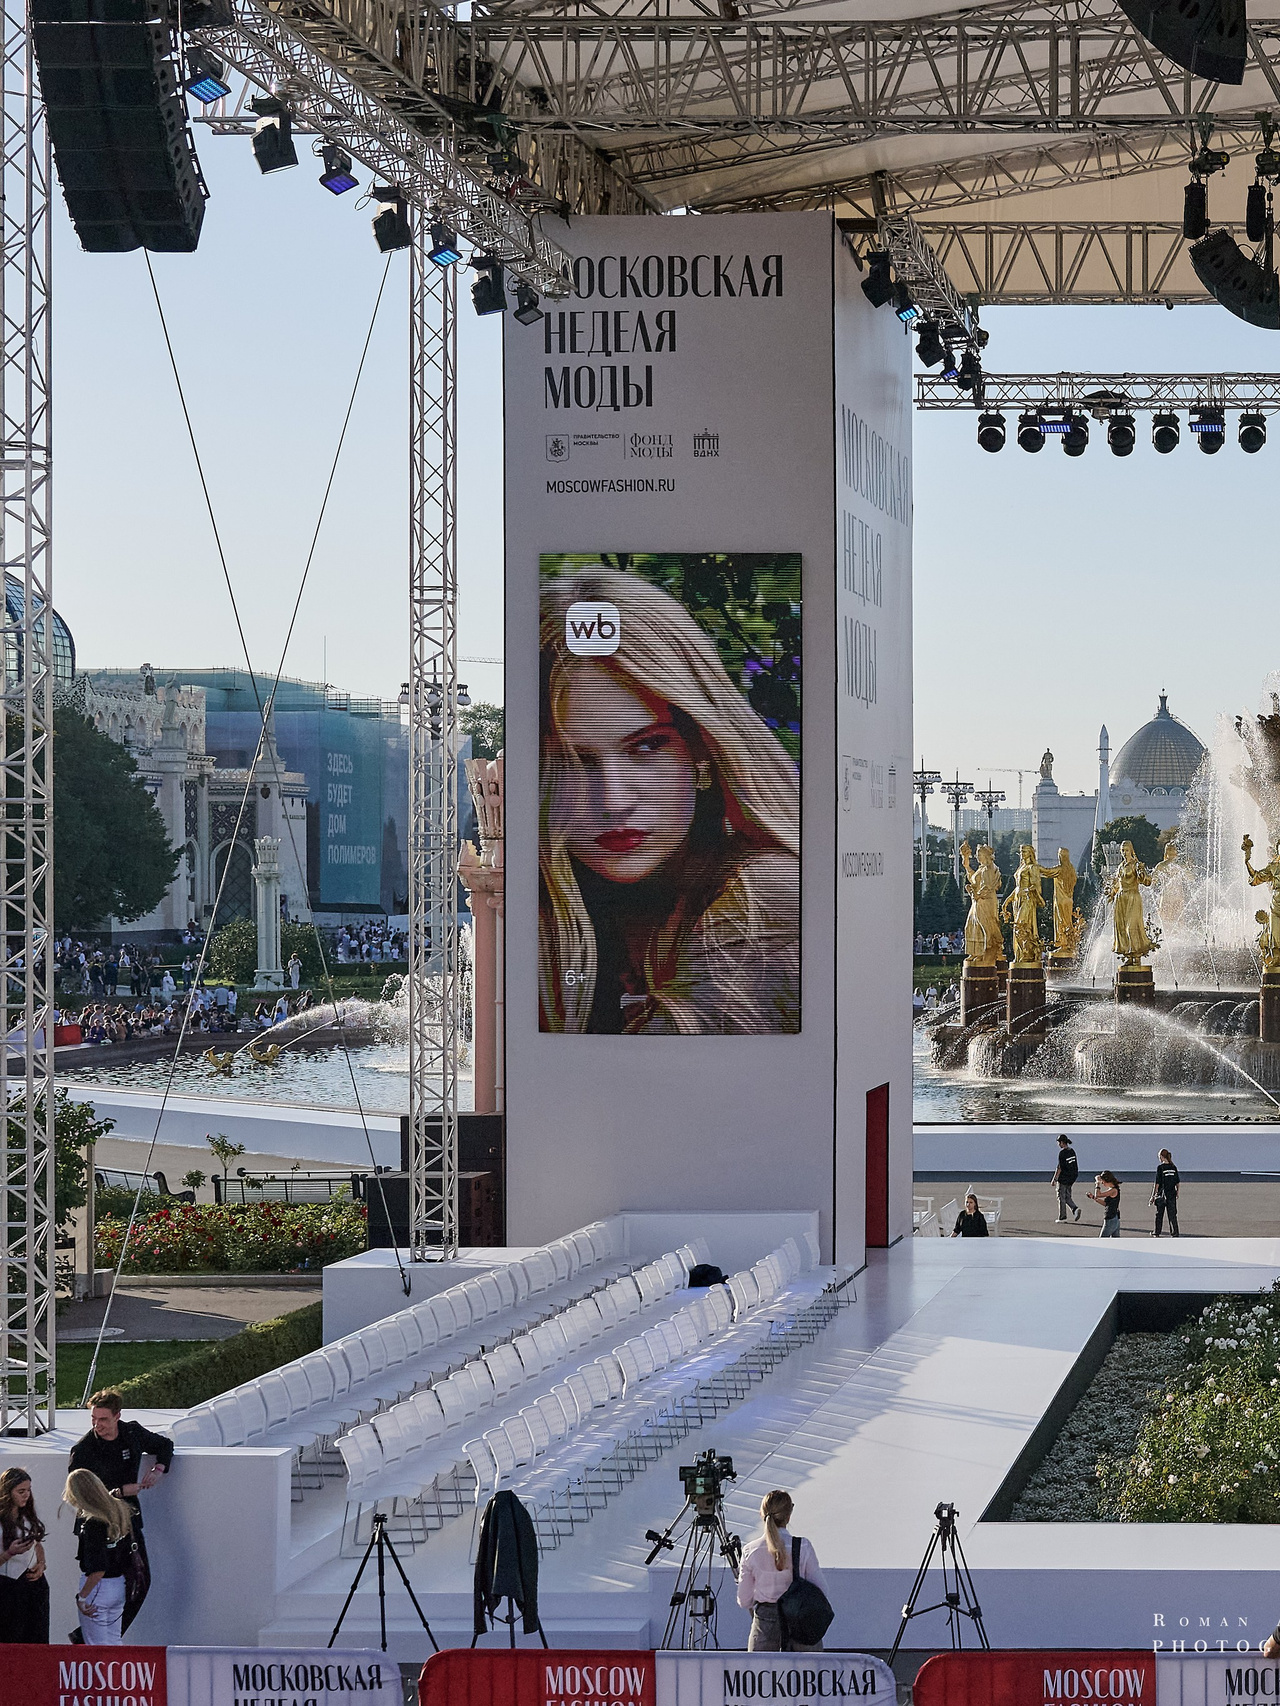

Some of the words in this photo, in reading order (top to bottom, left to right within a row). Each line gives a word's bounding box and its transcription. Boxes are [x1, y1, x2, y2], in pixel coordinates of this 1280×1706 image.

[556, 254, 783, 299] ОСКОВСКАЯ
[544, 310, 677, 357] НЕДЕЛЯ
[544, 364, 653, 411] МОДЫ
[630, 433, 674, 447] ФОНД
[630, 447, 673, 459] МОДЫ
[693, 449, 720, 458] ВДНХ
[842, 403, 909, 527] МОСКОВСКАЯ
[546, 478, 675, 494] MOSCOWFASHION.RU
[843, 509, 882, 608] НЕДЕЛЯ
[570, 612, 616, 639] wb
[844, 615, 877, 710] МОДЫ
[327, 752, 354, 777] ЗДЕСЬ
[327, 783, 353, 807] БУДЕТ
[327, 814, 347, 837] ДОМ
[327, 844, 377, 865] ПОЛИМЕРОВ
[565, 969, 587, 986] 6+
[59, 1660, 156, 1691] MOSCOW
[232, 1664, 383, 1692] МОСКОВСКАЯ
[545, 1665, 646, 1697] MOSCOW
[723, 1669, 876, 1698] МОСКОВСКАЯ
[1043, 1668, 1145, 1699] MOSCOW
